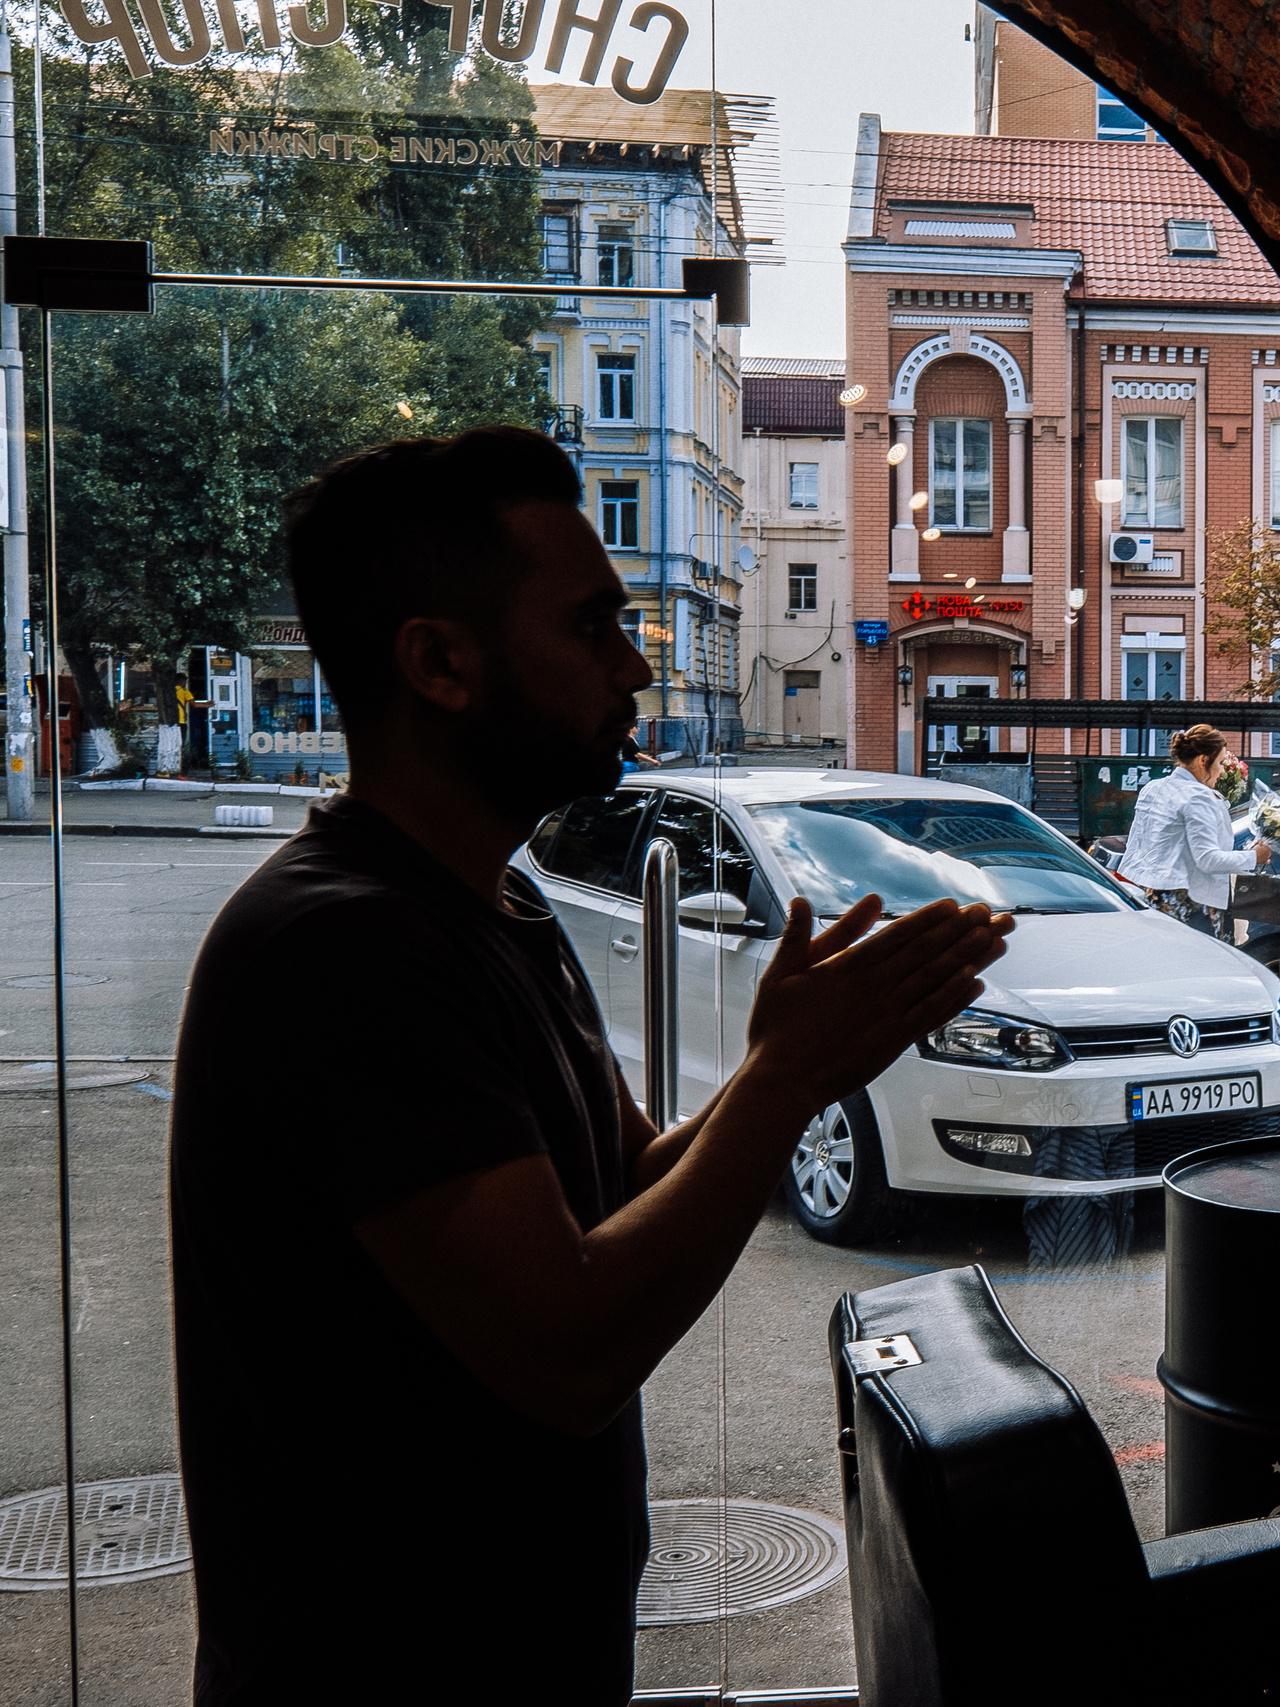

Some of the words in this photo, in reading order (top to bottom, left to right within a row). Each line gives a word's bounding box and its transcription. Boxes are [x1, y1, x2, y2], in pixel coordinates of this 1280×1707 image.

[936, 595, 972, 606] НОВА
[936, 606, 983, 617] ПОШТА
[260, 625, 309, 643] КОНД
[1146, 1088, 1175, 1116] AA
[1180, 1083, 1224, 1112] 9919
[1132, 1108, 1142, 1117] UA
